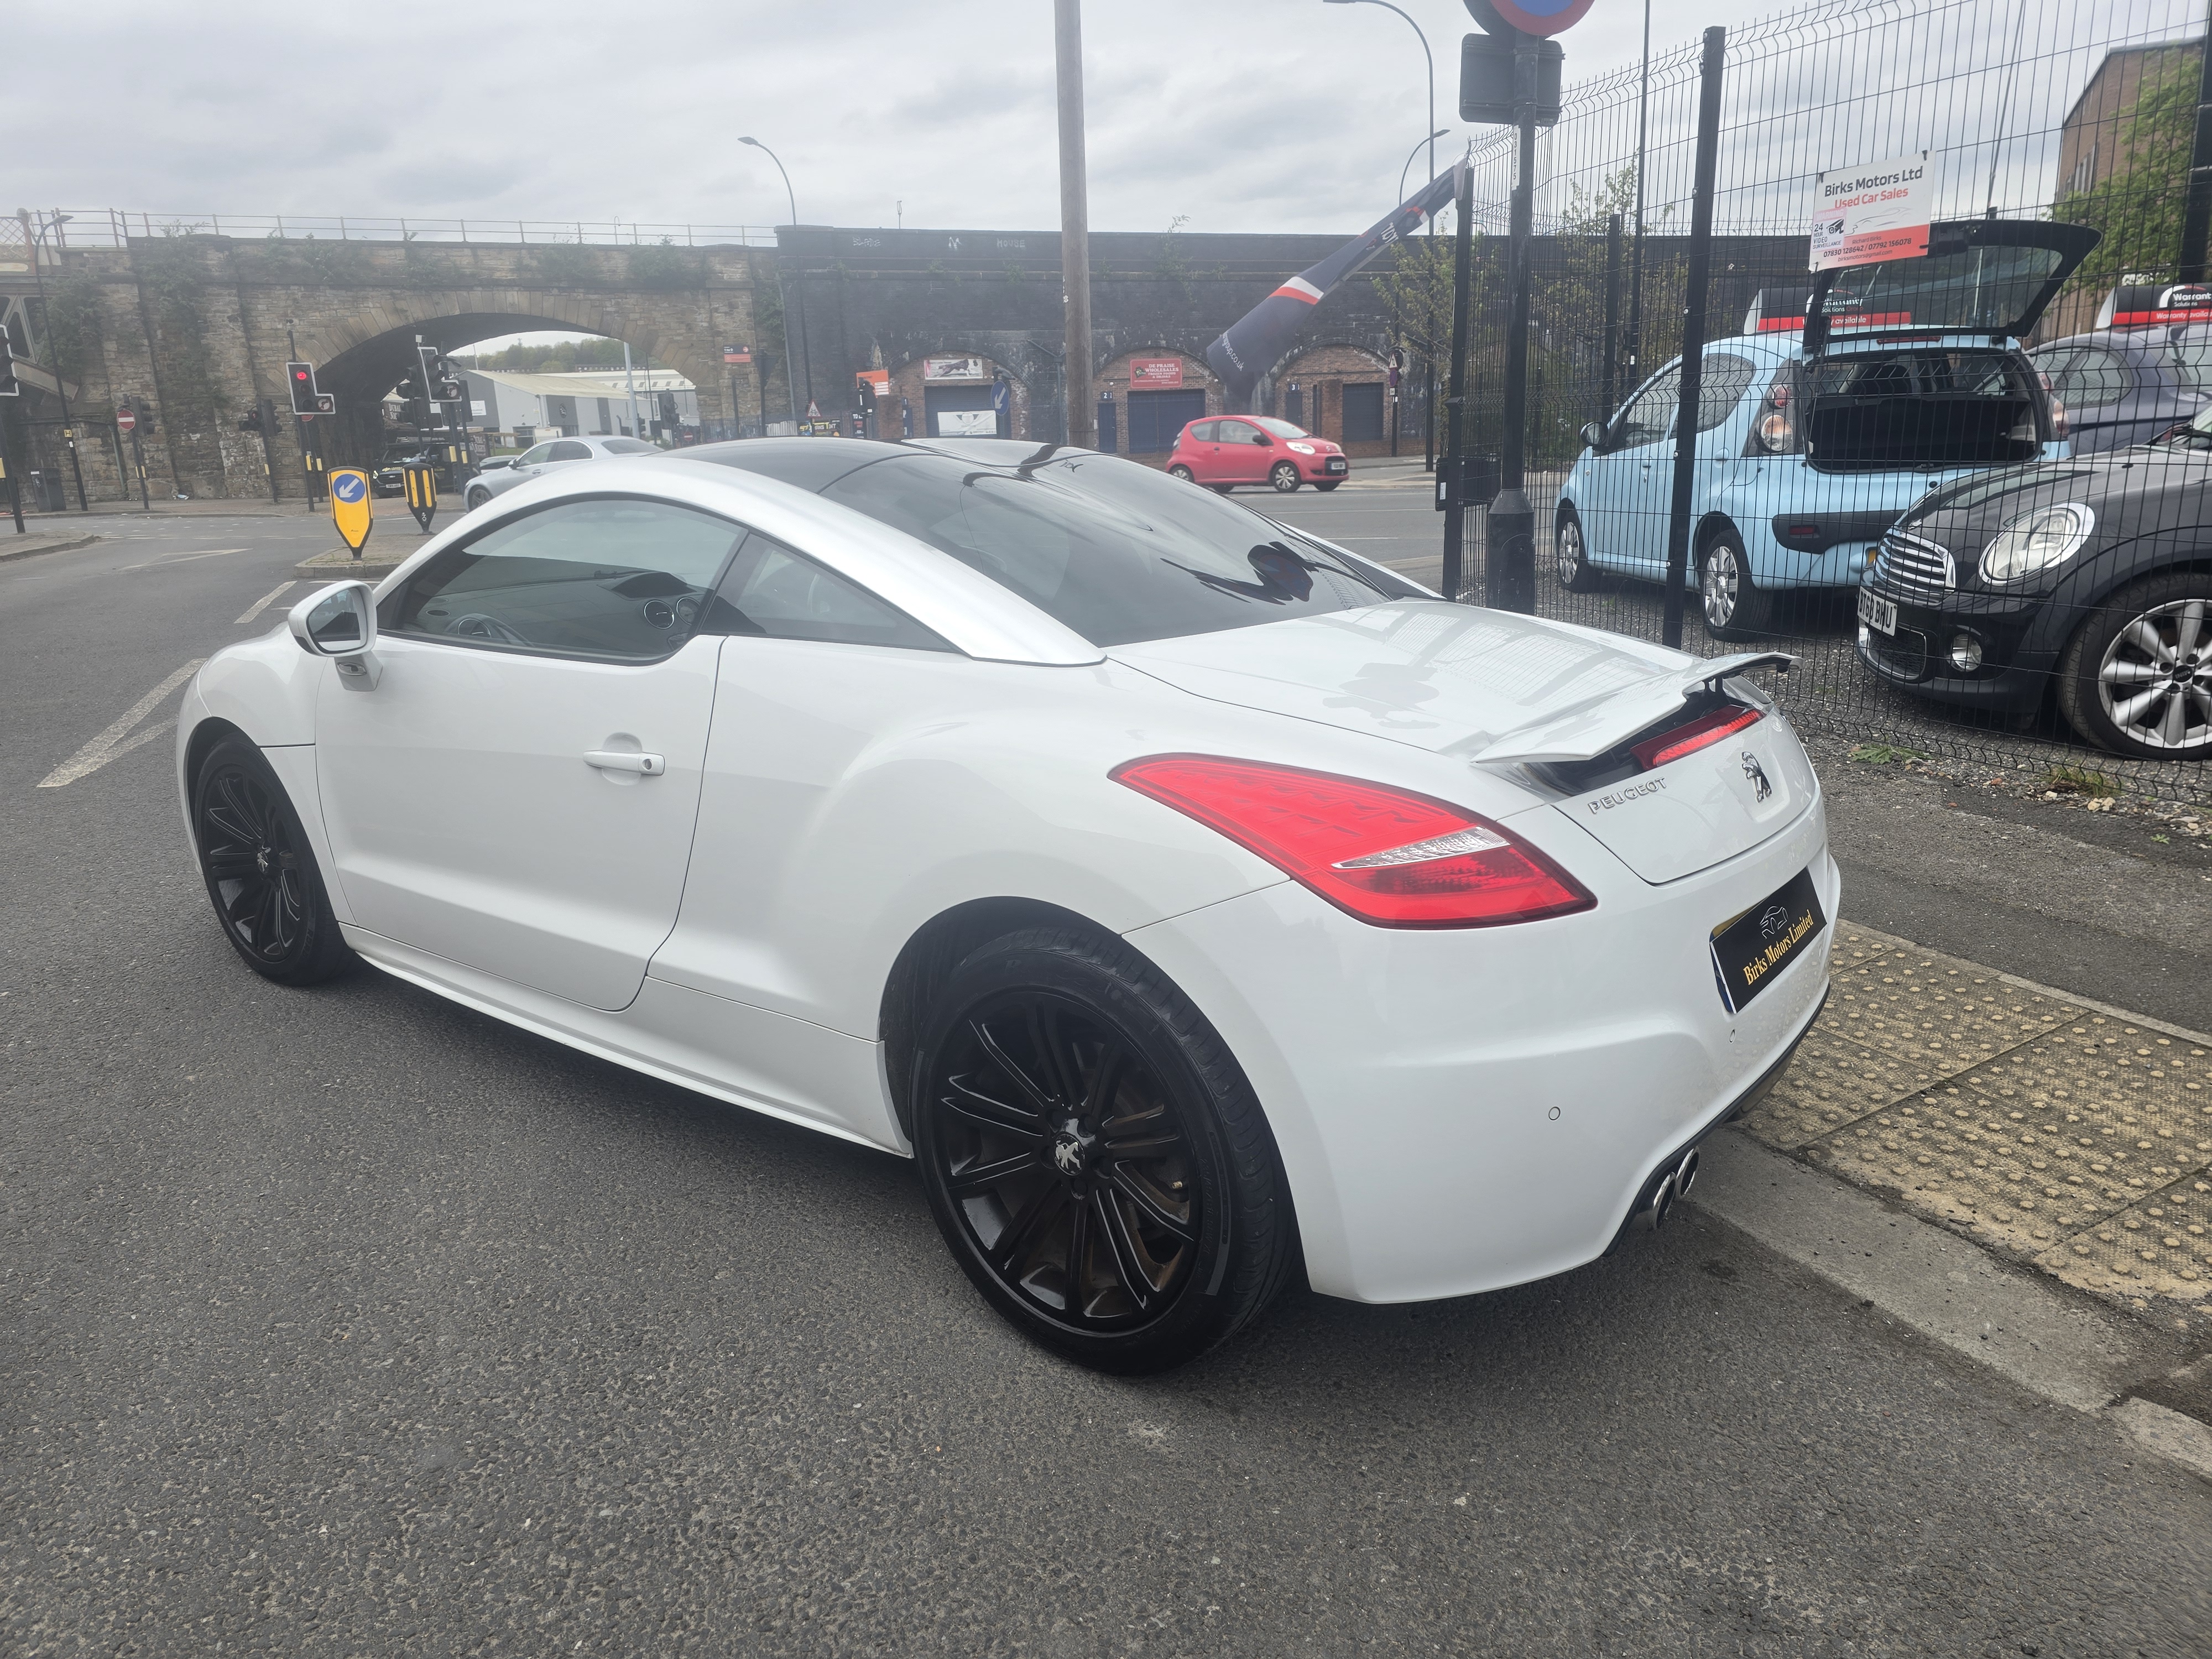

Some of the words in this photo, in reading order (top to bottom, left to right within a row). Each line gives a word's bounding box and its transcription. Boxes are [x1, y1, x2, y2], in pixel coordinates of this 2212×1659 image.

[1824, 181, 1853, 197] Birks
[1855, 173, 1900, 191] Motors
[1902, 165, 1923, 182] Ltd
[1835, 195, 1860, 208] Used
[1861, 194, 1878, 204] Car
[1880, 187, 1908, 201] Sales
[1816, 210, 1844, 221] WARNING
[1814, 222, 1823, 232] 24
[997, 238, 1026, 248] HOUSE
[1813, 240, 1842, 249] SURVEILLANCE
[1823, 249, 1841, 258] 07830
[1843, 246, 1864, 254] 128642
[1868, 241, 1887, 250] 07792
[1889, 238, 1912, 247] 156078
[1838, 250, 1892, 262] birksmotors@gmail.com
[1874, 600, 1893, 629] BHU
[1588, 776, 1667, 814] PEUGEOT
[1743, 957, 1768, 985] Birks
[1764, 936, 1792, 966] Motors
[1788, 909, 1814, 944] Limited
